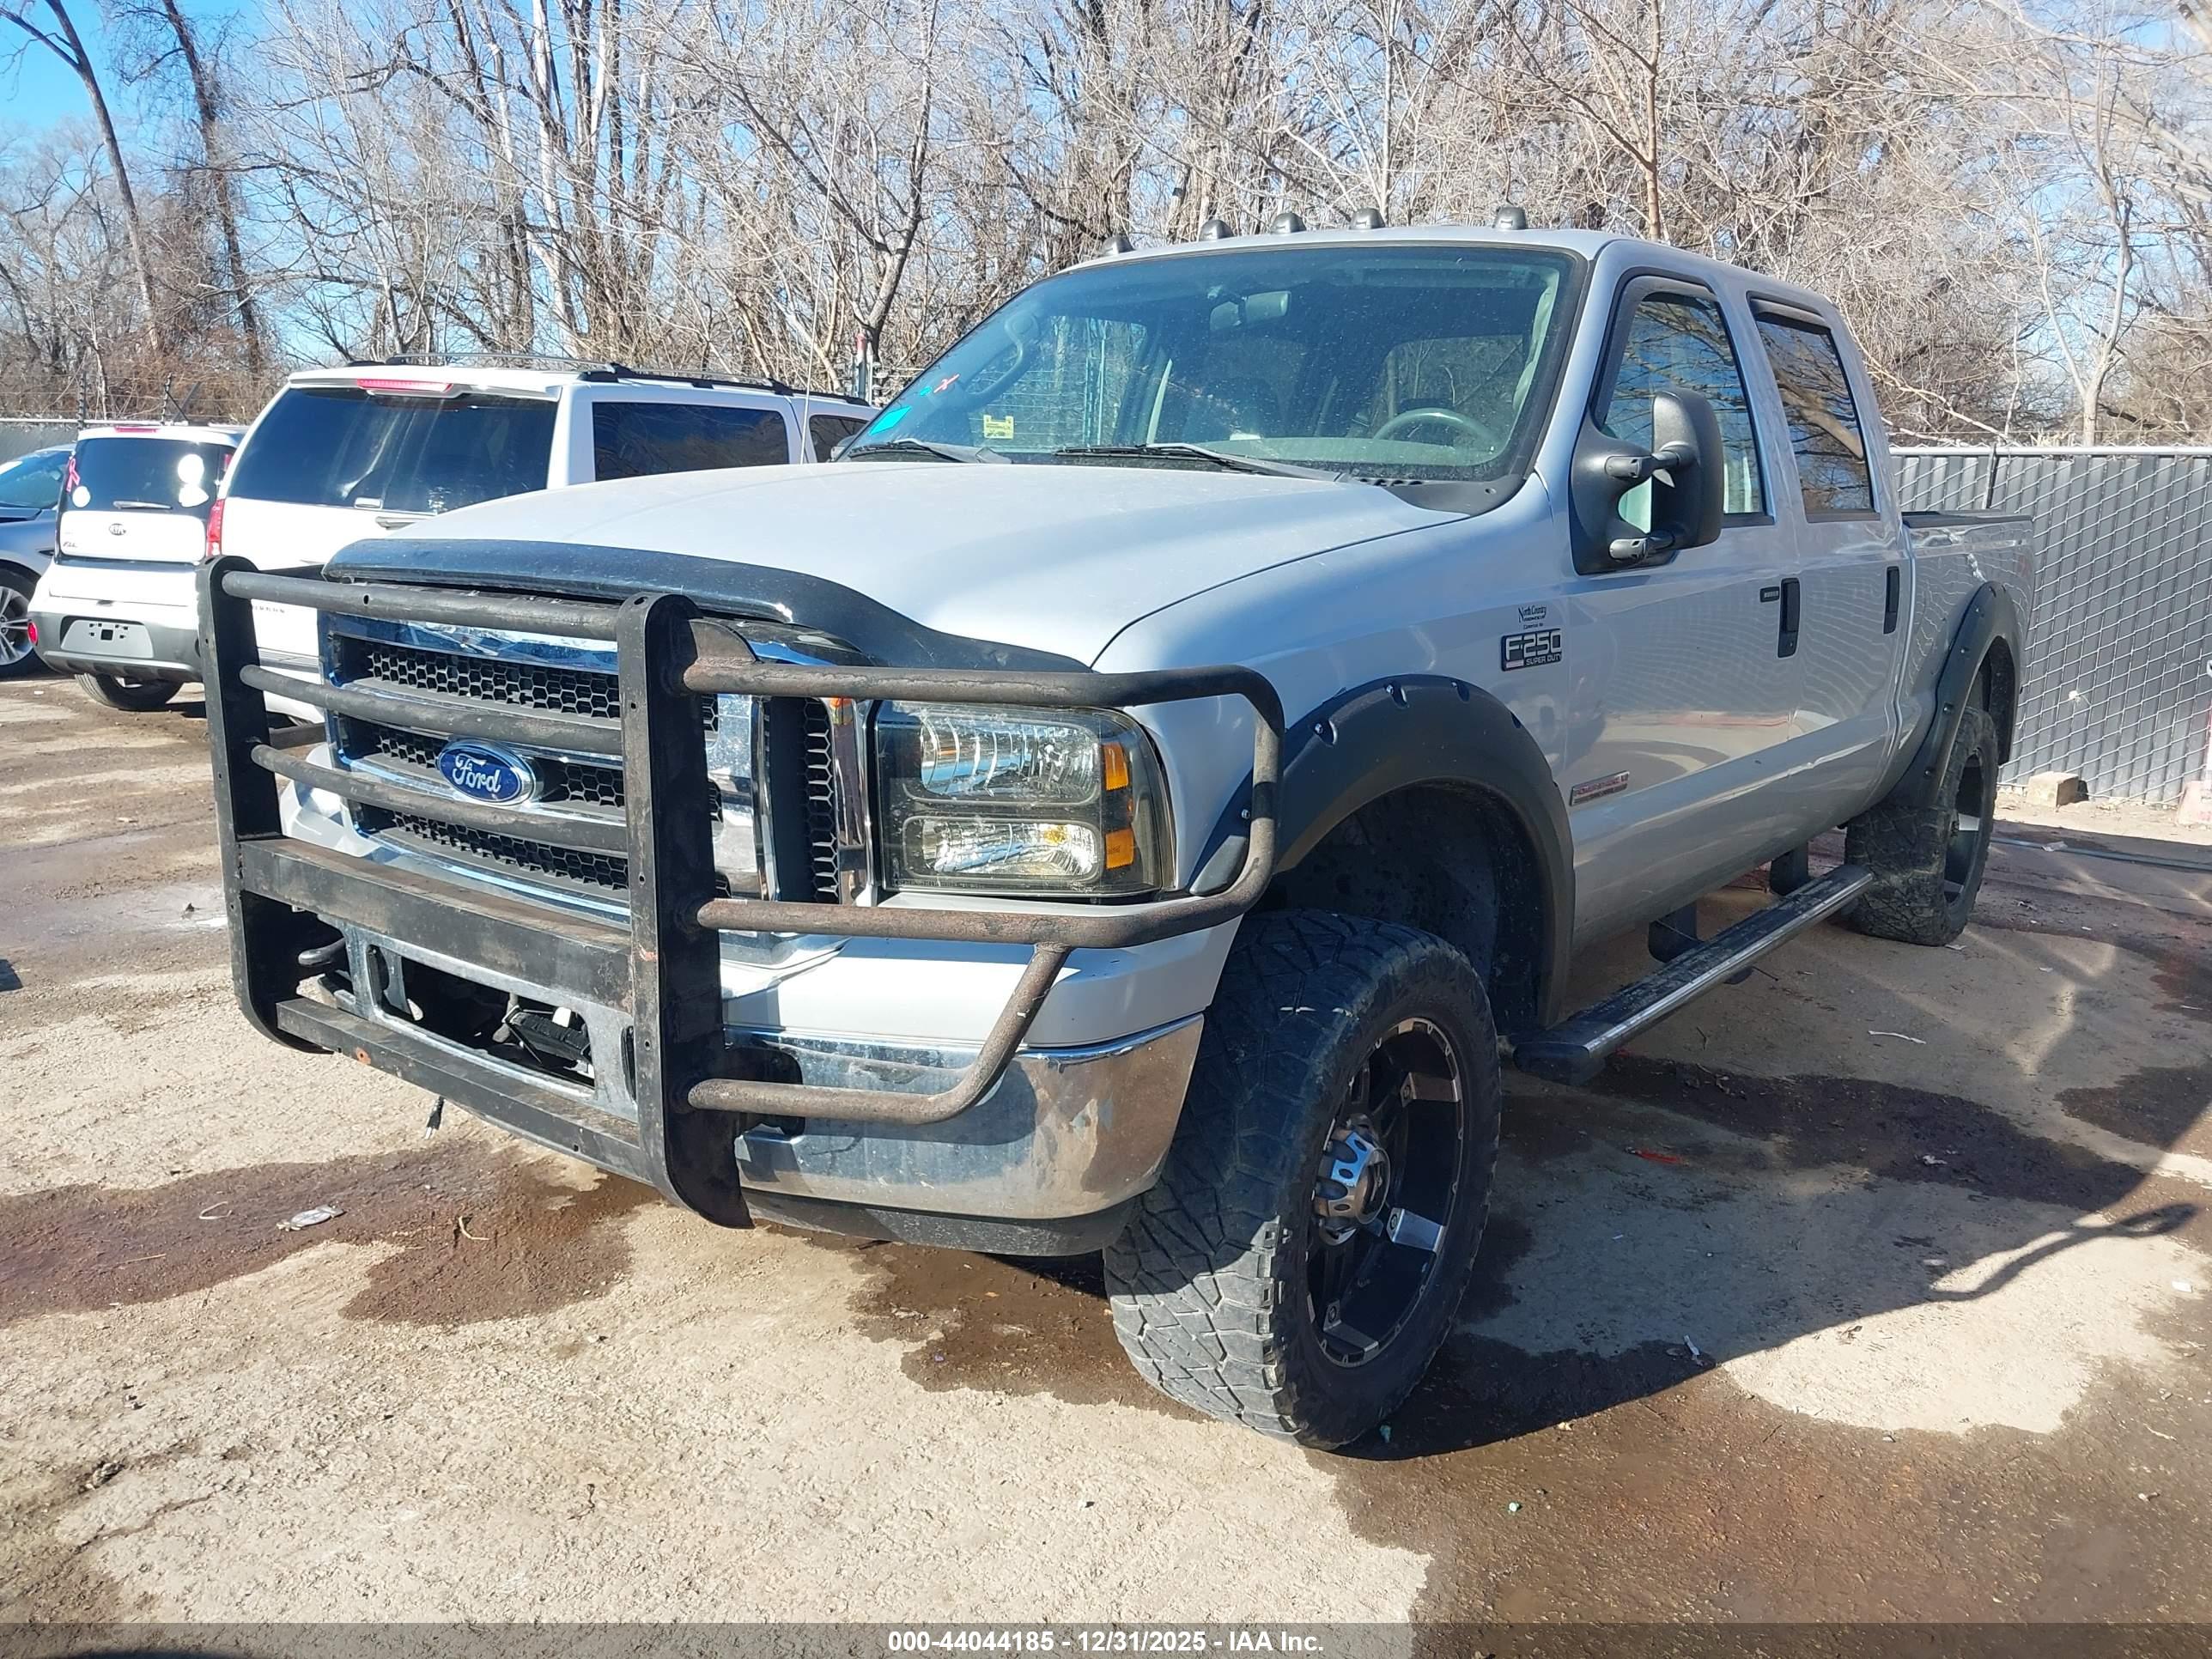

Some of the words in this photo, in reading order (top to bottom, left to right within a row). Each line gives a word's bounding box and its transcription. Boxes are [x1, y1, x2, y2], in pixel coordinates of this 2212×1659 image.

[1526, 656, 1546, 665] SUPER
[1547, 653, 1561, 662] DUTY
[452, 752, 501, 793] Ford
